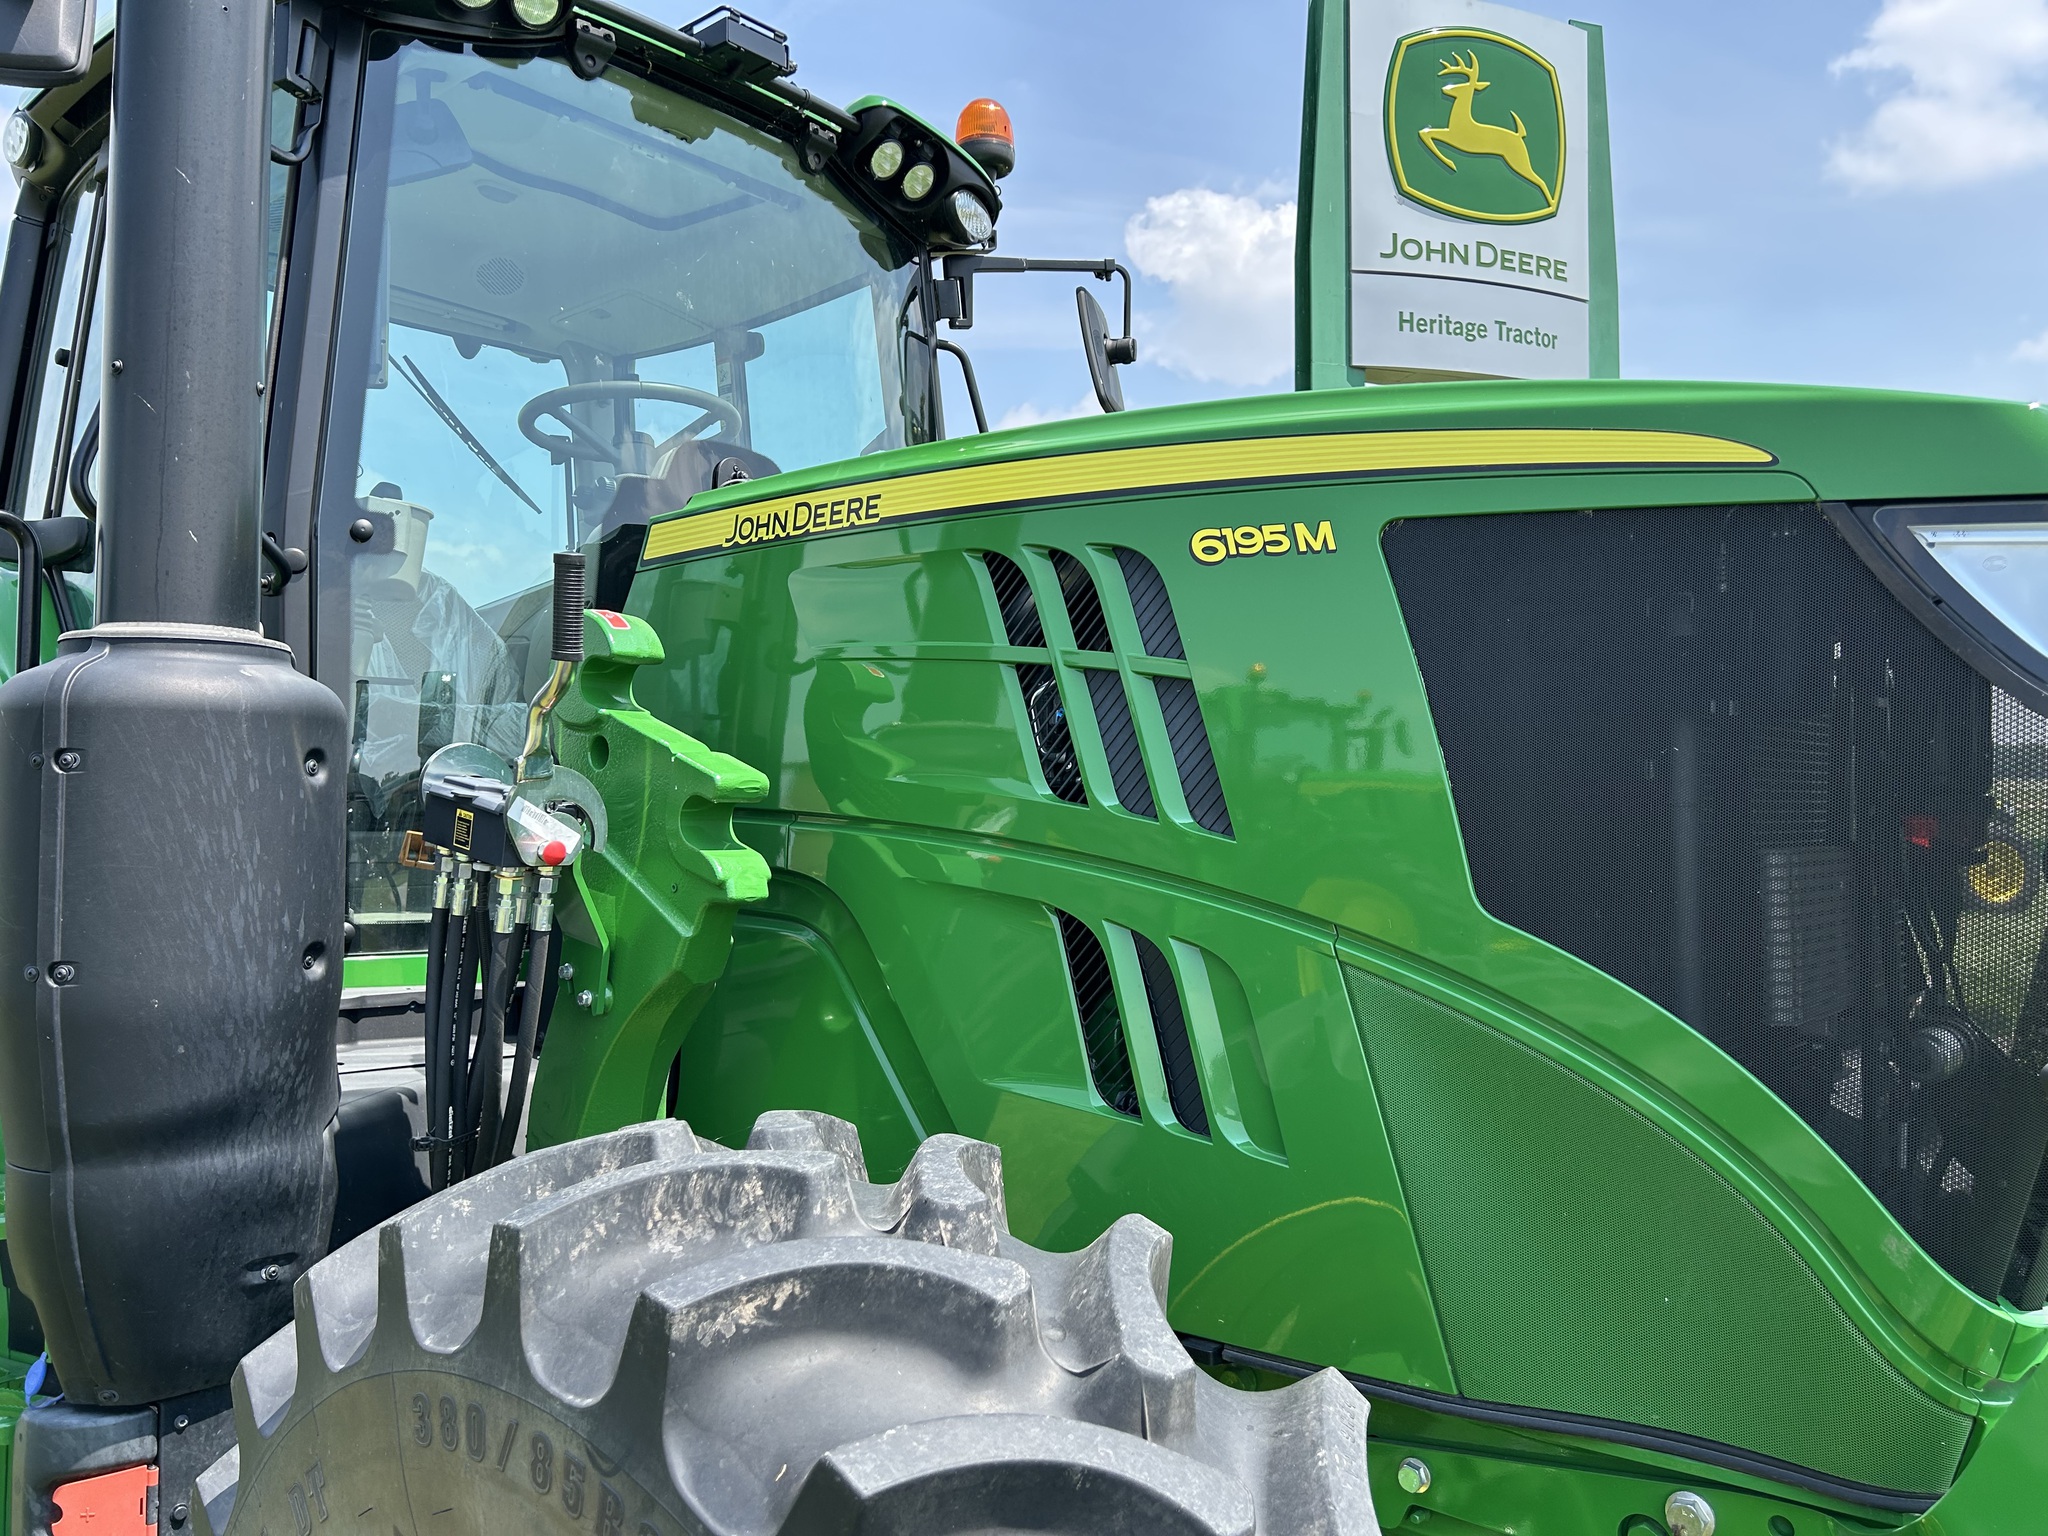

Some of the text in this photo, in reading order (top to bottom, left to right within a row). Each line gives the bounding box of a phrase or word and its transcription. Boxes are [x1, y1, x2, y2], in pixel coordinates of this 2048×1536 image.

[1380, 233, 1568, 282] JOHN DEERE
[1398, 311, 1558, 350] Heritage Tractor
[724, 494, 882, 544] JOHN DEERE
